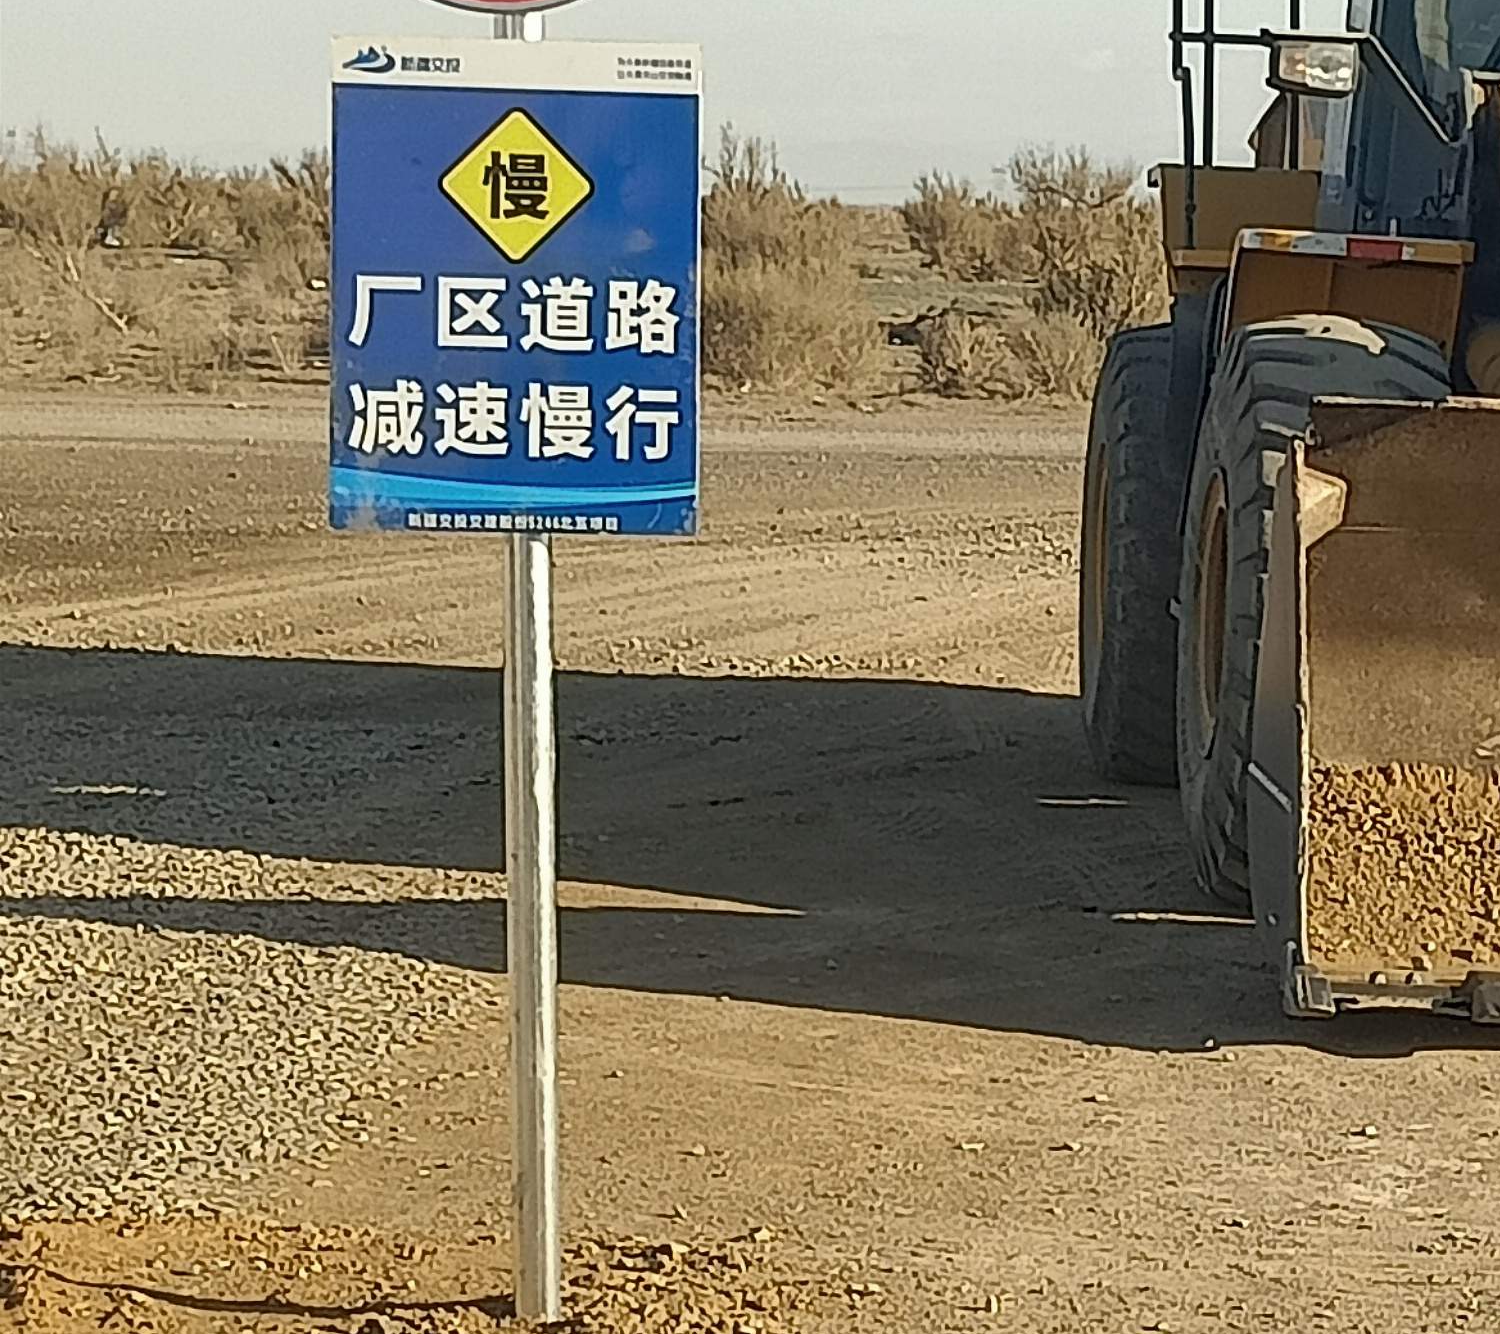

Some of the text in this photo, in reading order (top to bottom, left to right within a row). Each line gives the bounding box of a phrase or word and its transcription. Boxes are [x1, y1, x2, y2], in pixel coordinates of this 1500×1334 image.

[483, 151, 549, 219] 慢
[348, 274, 680, 354] 厂区道路
[348, 379, 679, 460] 减速慢行
